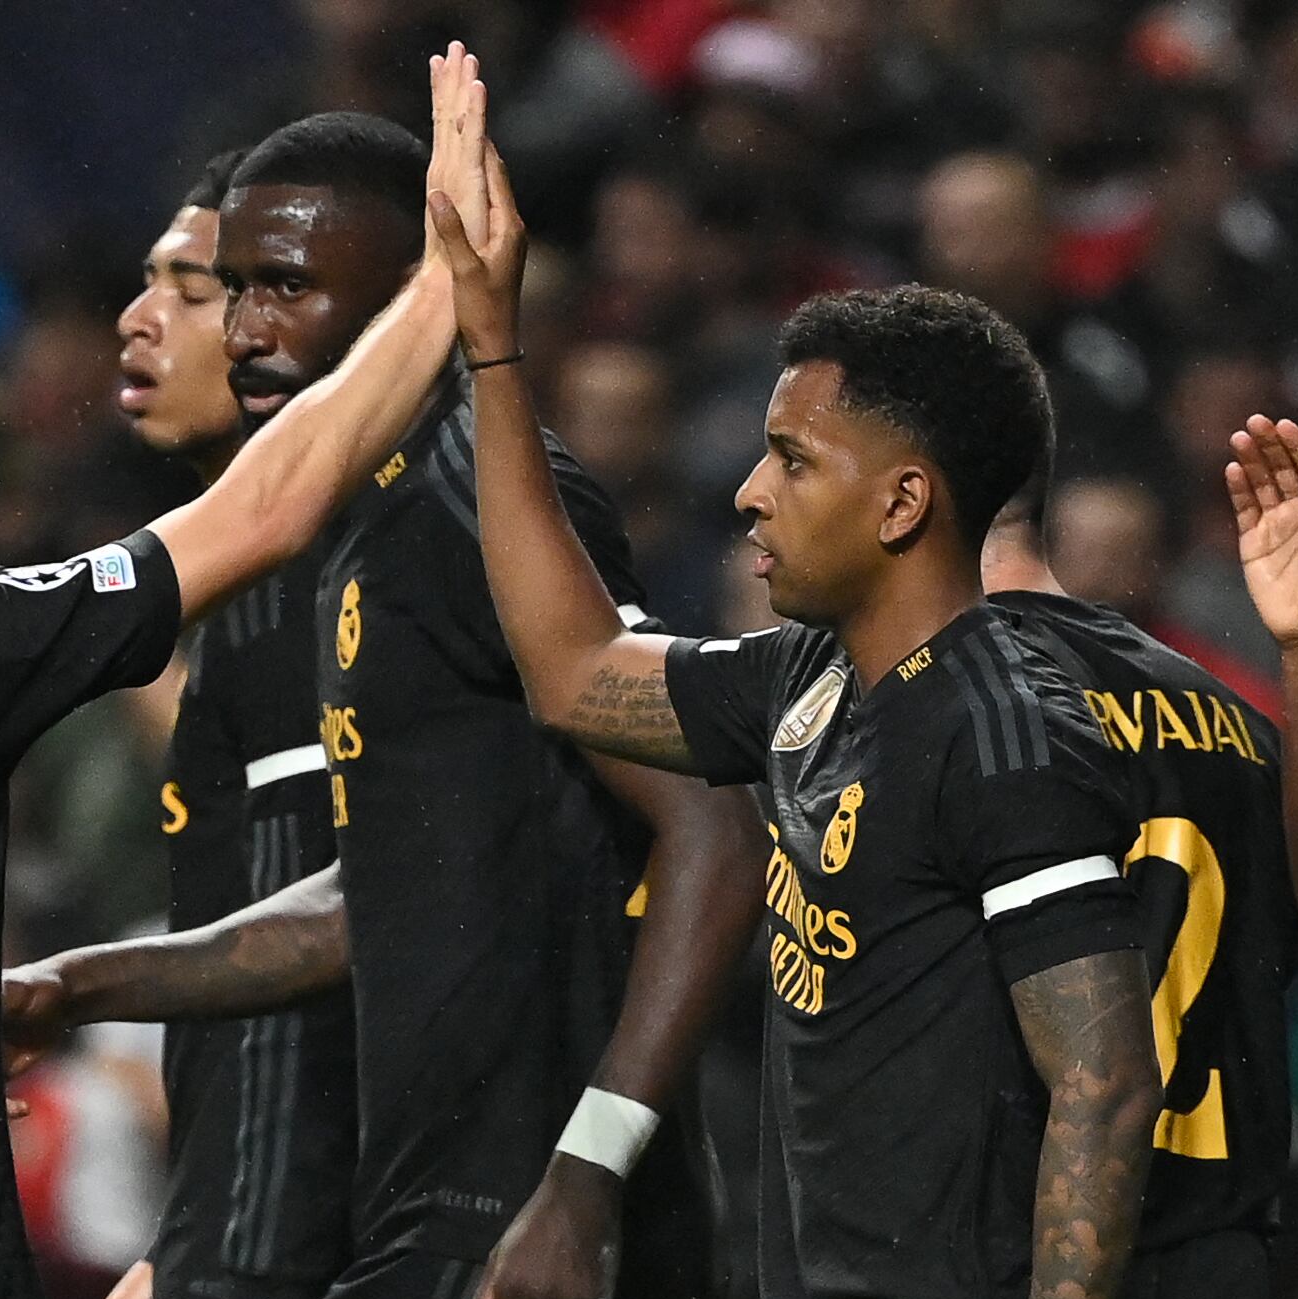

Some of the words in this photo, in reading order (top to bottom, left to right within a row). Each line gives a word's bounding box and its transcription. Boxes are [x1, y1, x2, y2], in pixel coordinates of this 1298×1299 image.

[896, 646, 933, 682] RMCF
[1082, 688, 1267, 765] RVAJAL
[1122, 816, 1230, 1160] 2
